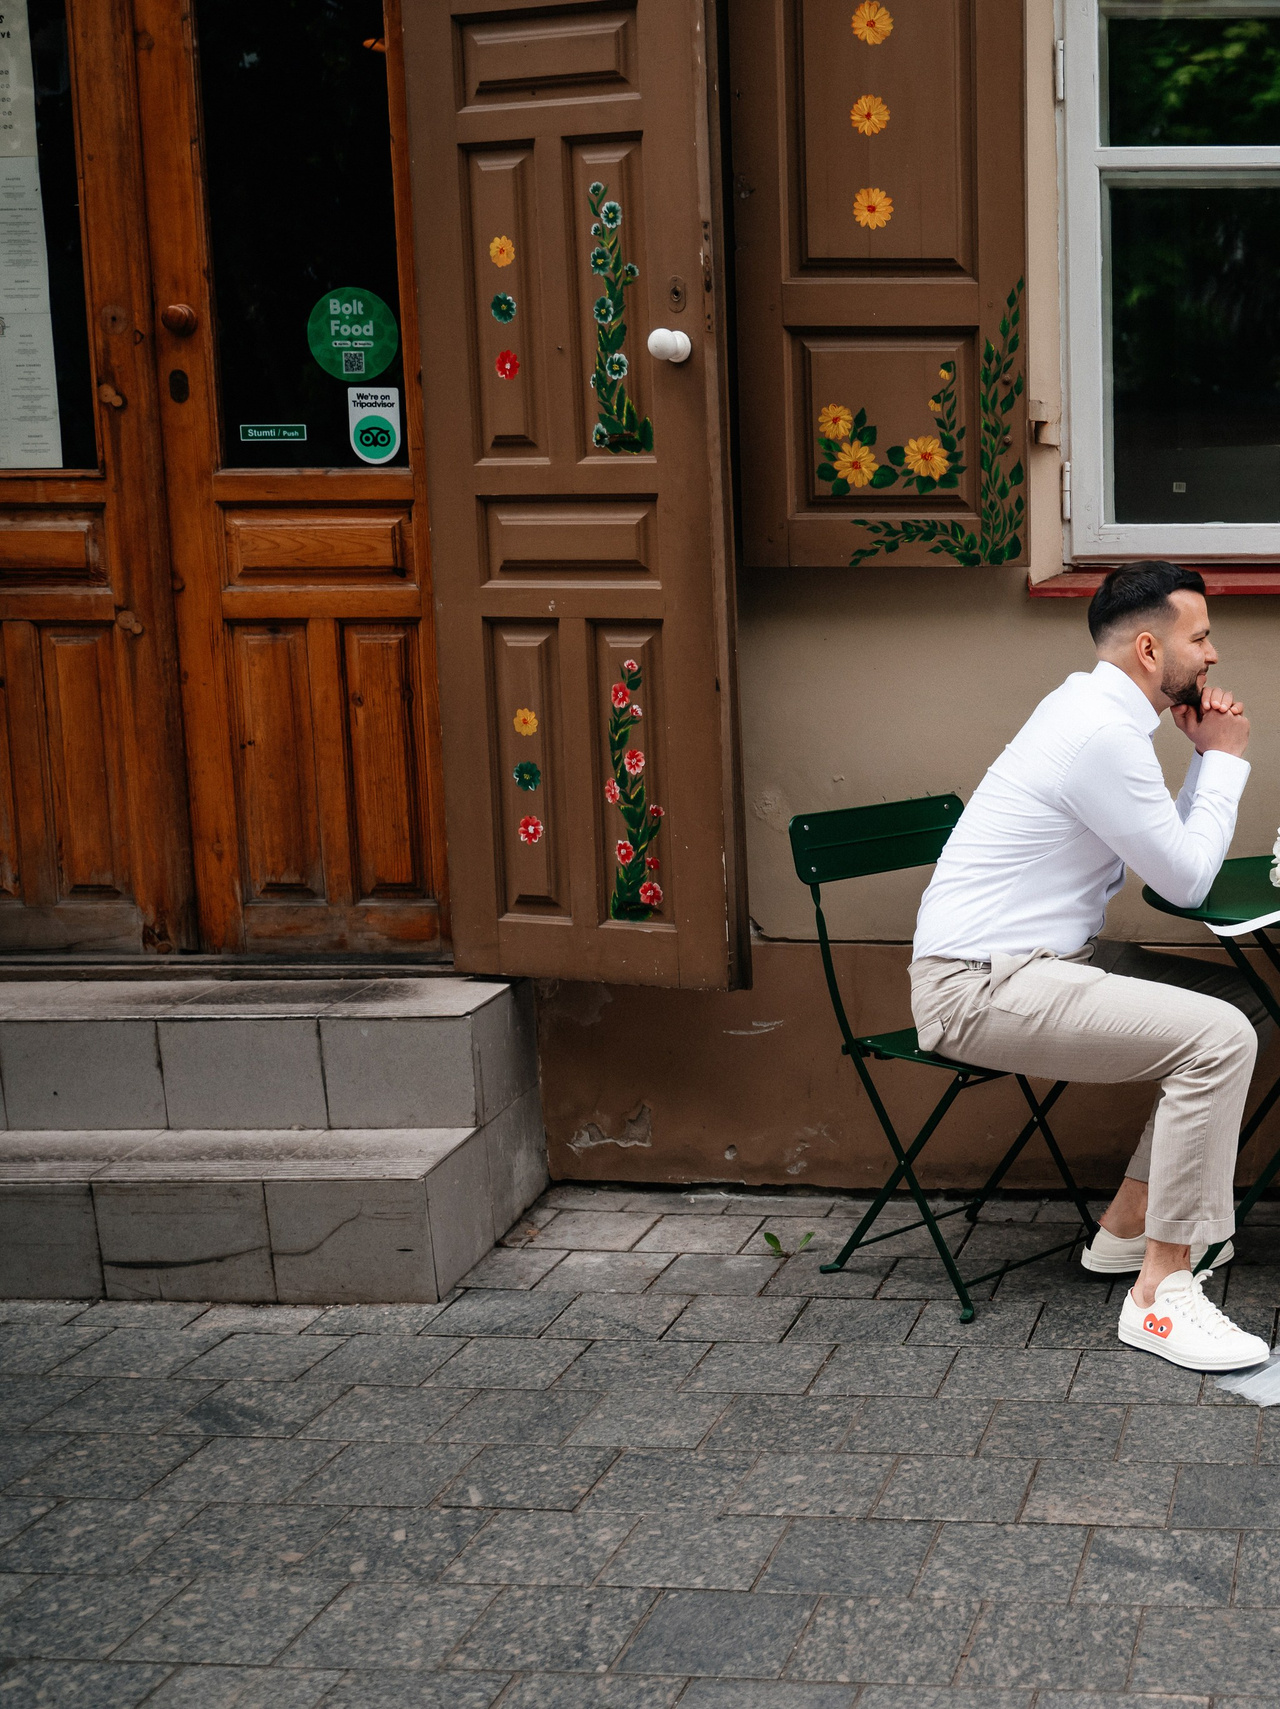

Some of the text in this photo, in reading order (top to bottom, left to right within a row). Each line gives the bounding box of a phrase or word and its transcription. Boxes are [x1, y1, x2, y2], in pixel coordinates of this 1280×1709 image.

[329, 298, 364, 315] Bolt
[330, 320, 374, 336] Food
[352, 400, 395, 409] Tripadvisor
[247, 428, 276, 437] Stumti
